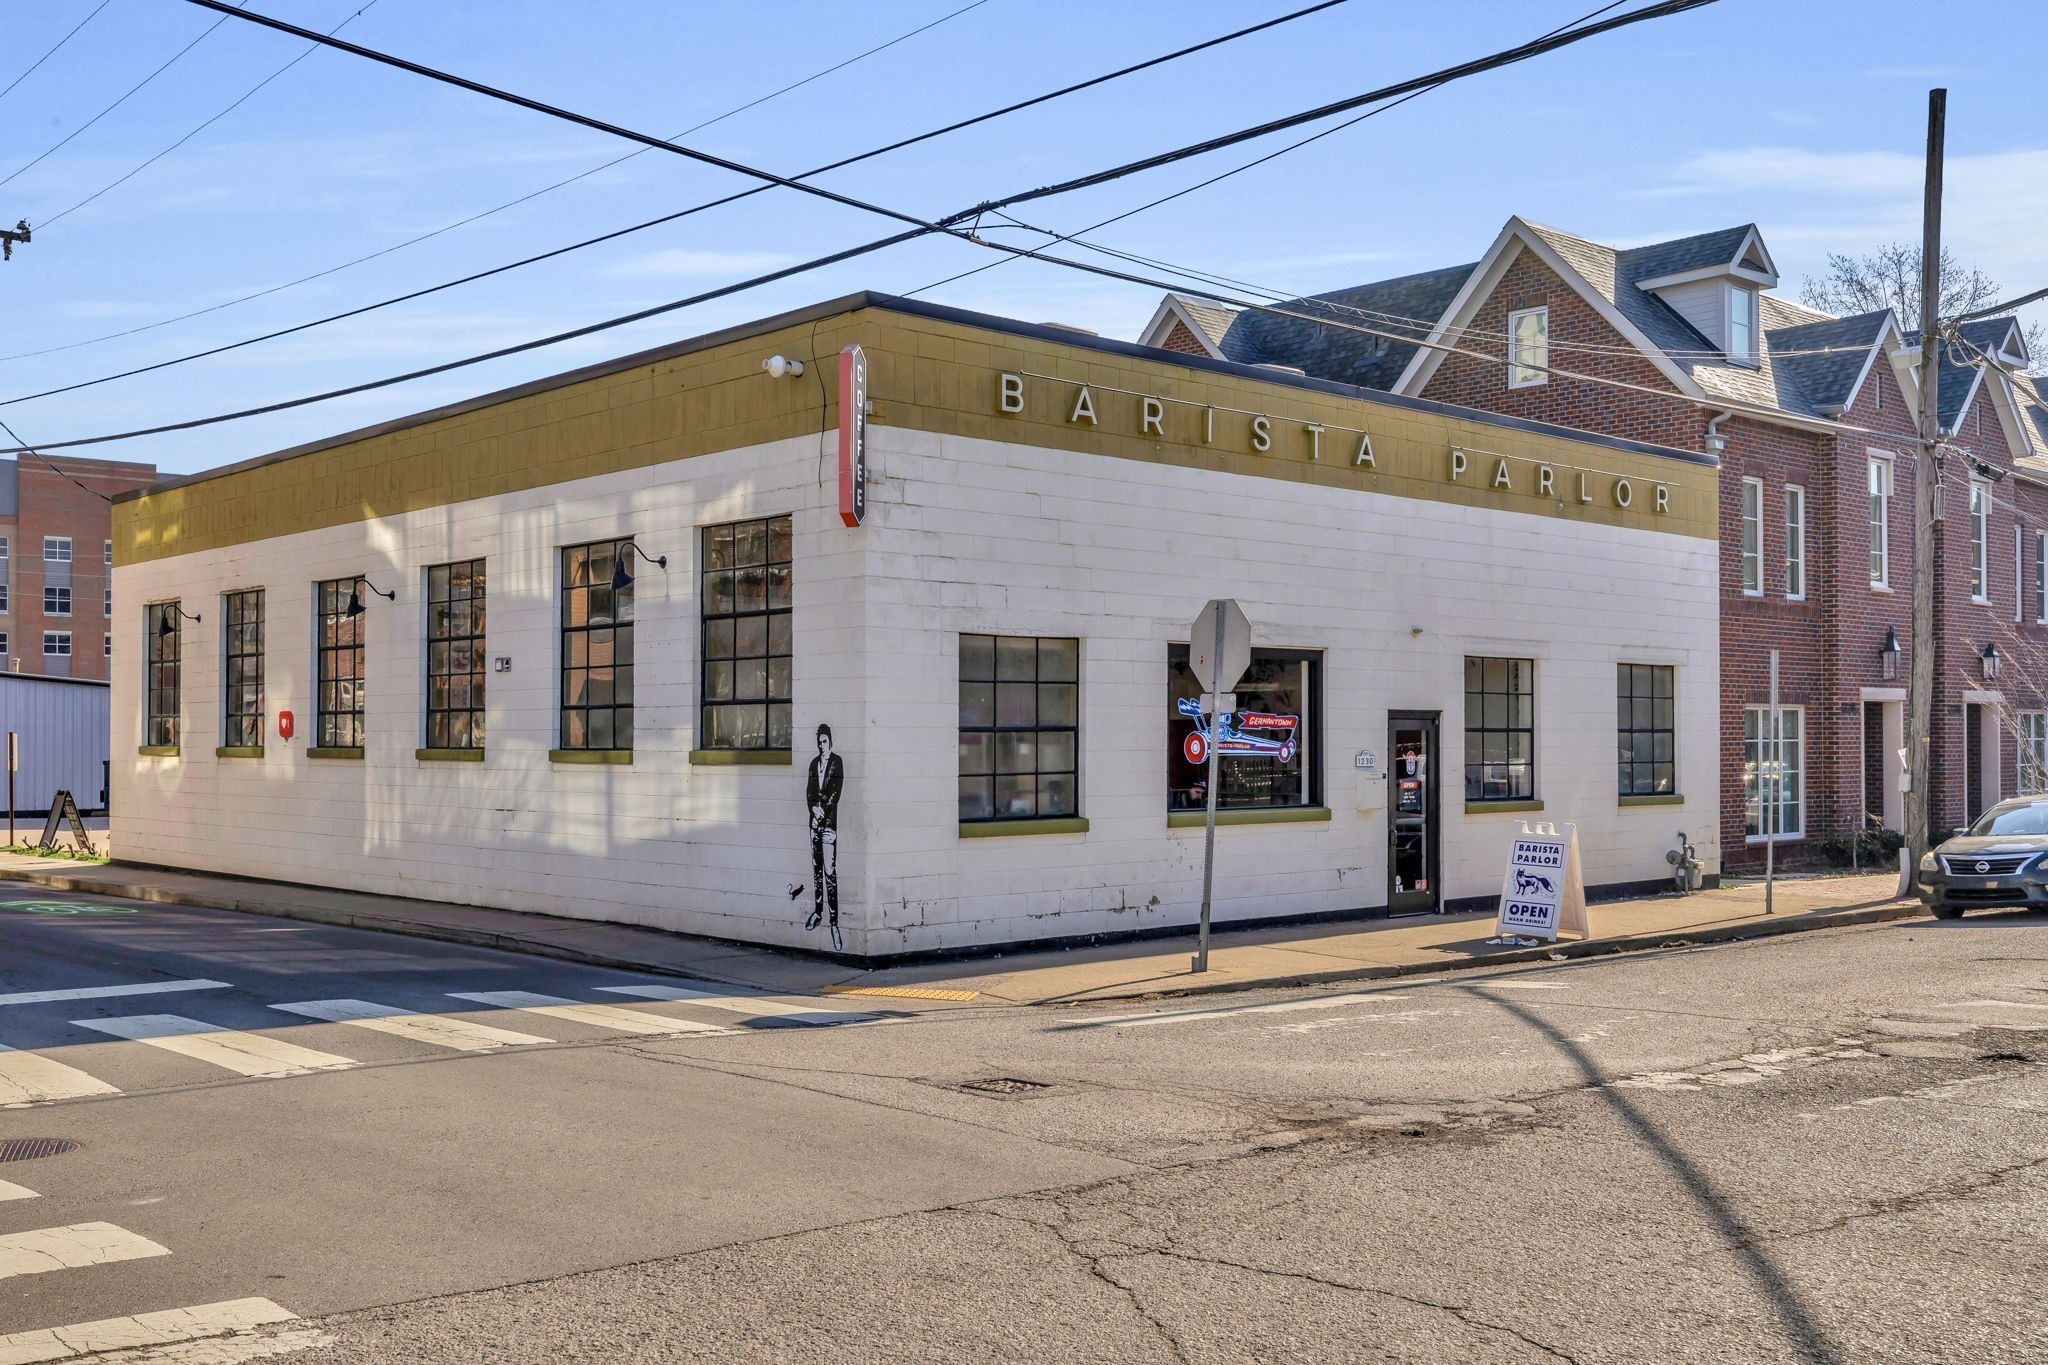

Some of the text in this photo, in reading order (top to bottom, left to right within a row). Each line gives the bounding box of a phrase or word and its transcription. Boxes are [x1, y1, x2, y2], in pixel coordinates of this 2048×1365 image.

[1001, 373, 1669, 513] BARISTA PARLOR
[1249, 716, 1293, 726] GERMANTOWN
[1358, 757, 1374, 765] 1230
[1518, 844, 1560, 855] BARISTA
[1517, 854, 1558, 865] PARLOR
[1509, 904, 1549, 919] OPEN
